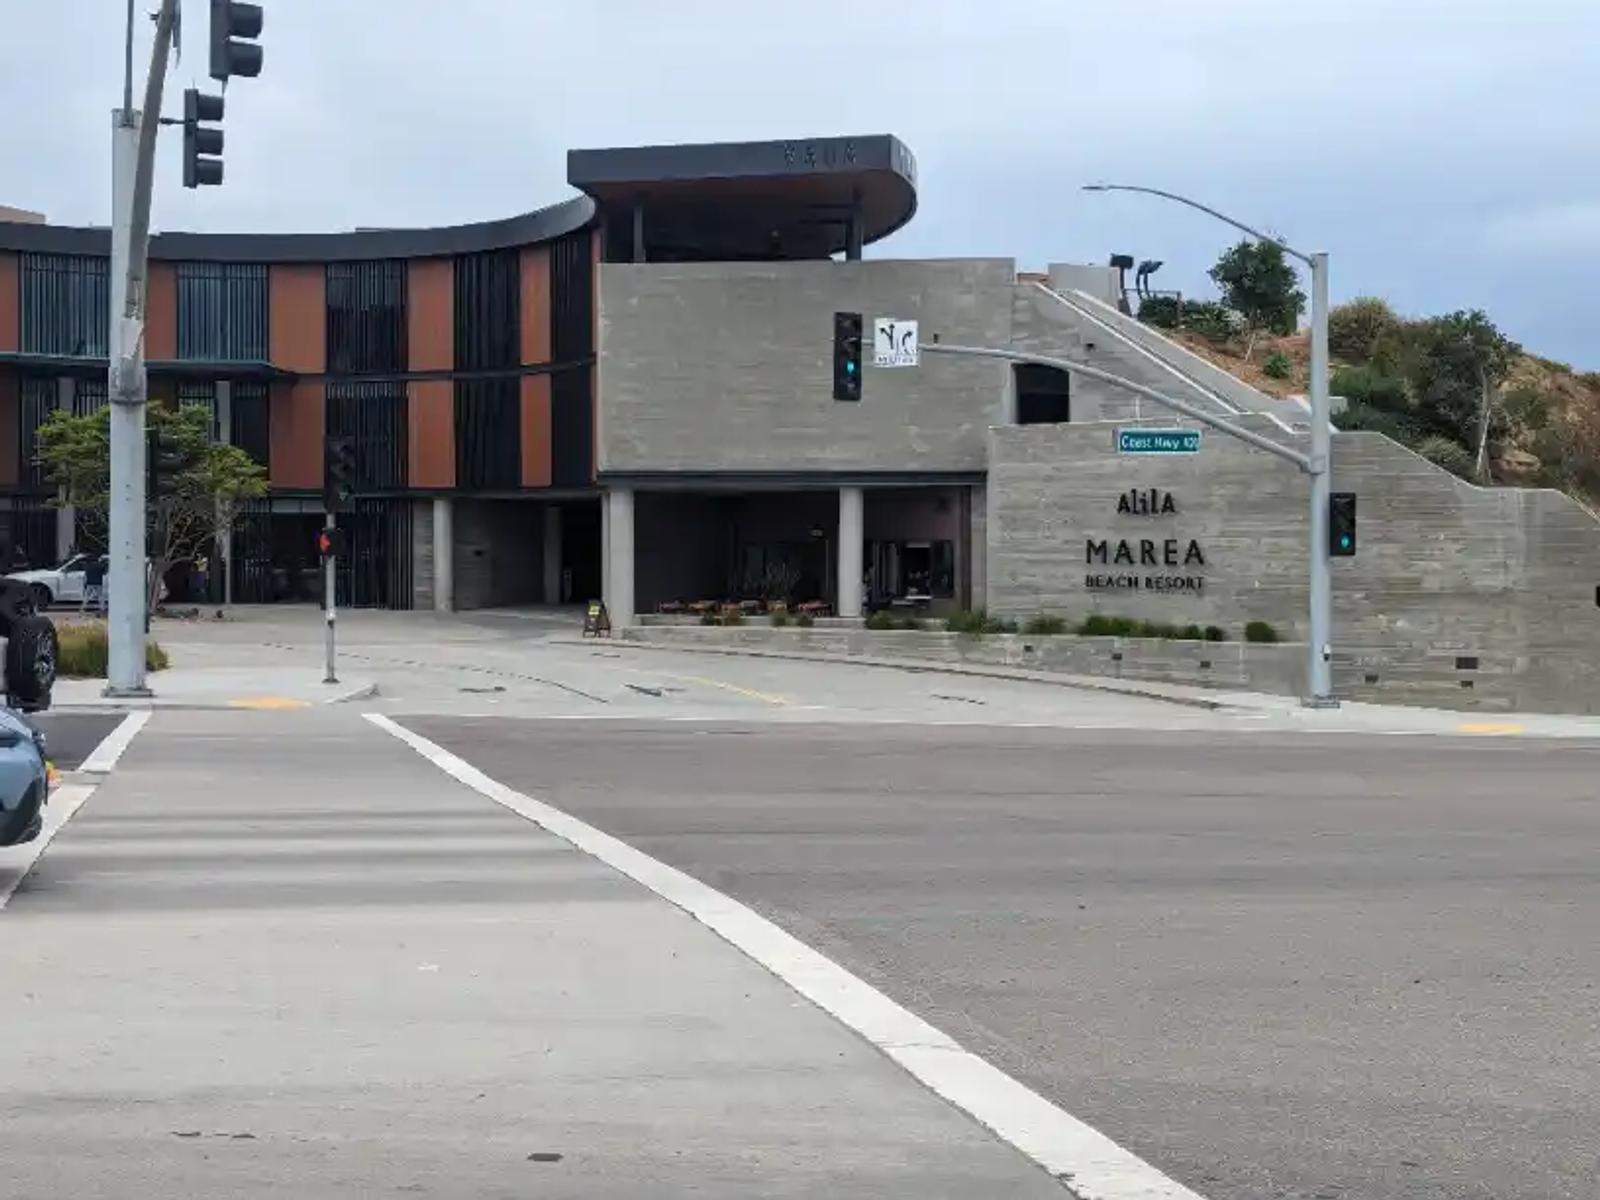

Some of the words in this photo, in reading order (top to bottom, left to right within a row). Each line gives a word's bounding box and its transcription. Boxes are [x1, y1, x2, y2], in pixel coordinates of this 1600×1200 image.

[1085, 539, 1205, 565] MAREA
[1085, 575, 1139, 588] BEACH
[1144, 576, 1205, 590] RESORT
